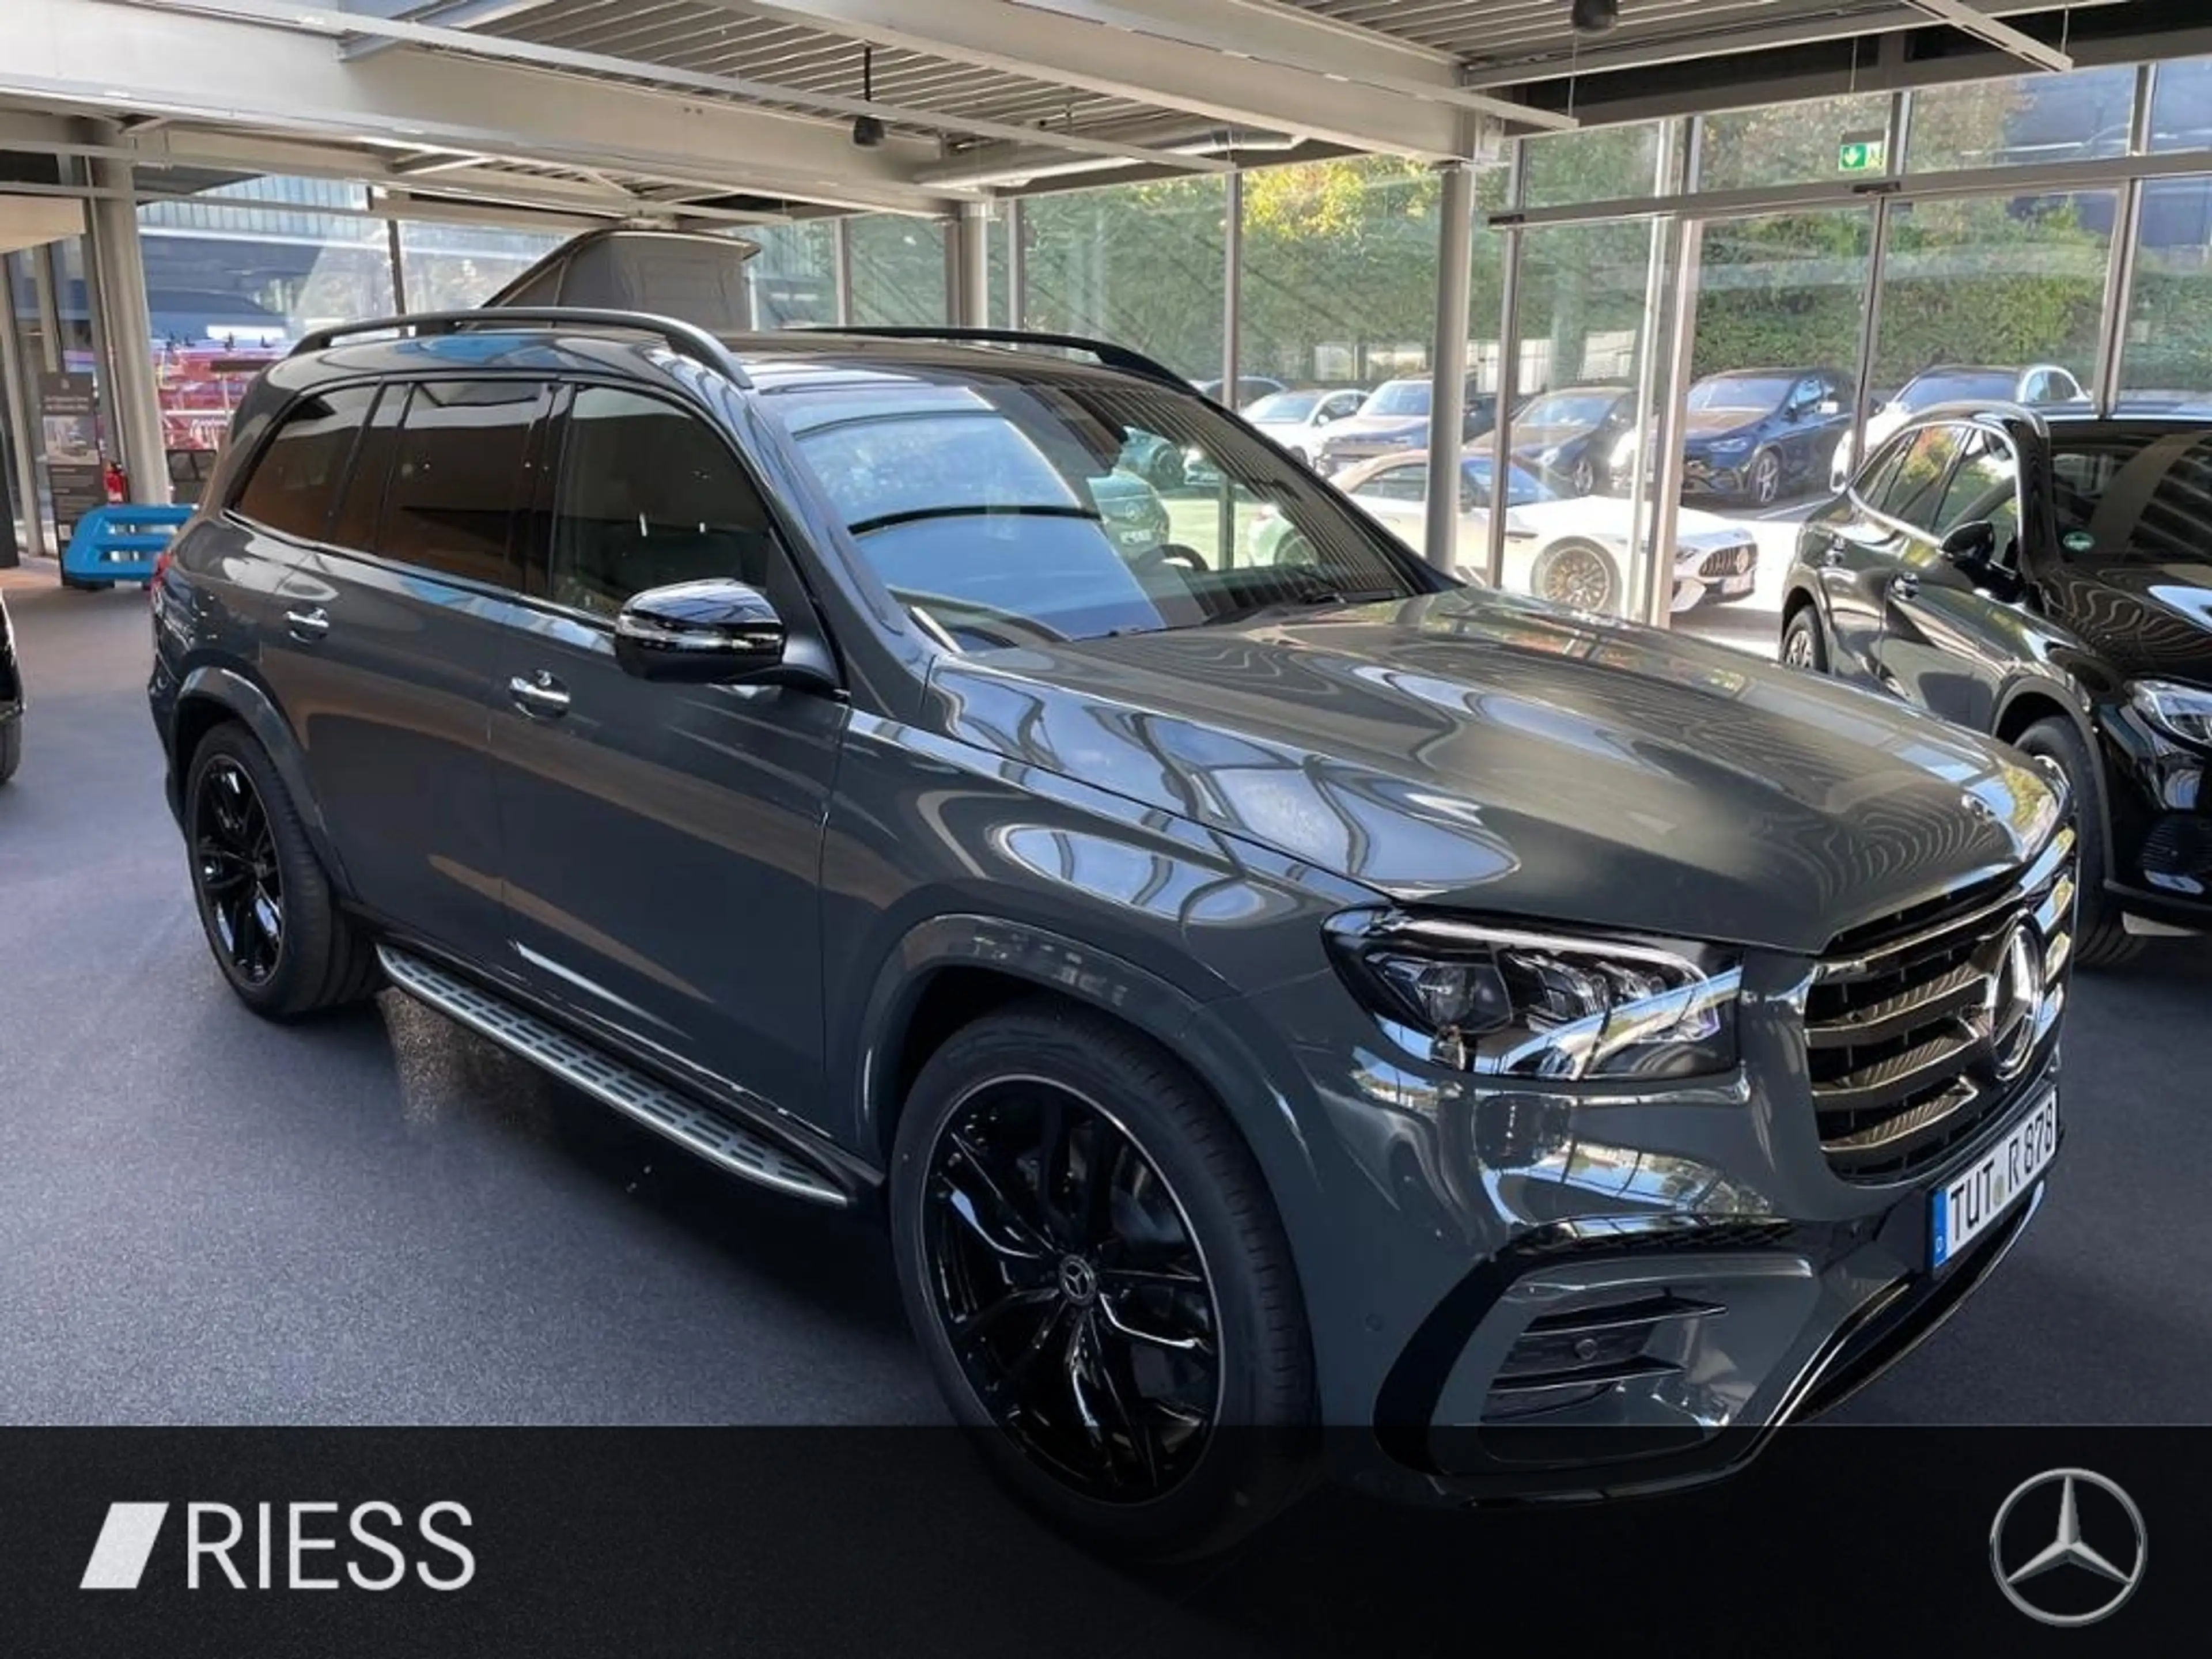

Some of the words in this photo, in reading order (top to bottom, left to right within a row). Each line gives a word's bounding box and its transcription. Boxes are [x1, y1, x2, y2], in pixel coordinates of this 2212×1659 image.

[1950, 1158, 1994, 1241] TUT
[2008, 1137, 2018, 1193] R
[2024, 1102, 2052, 1175] 878
